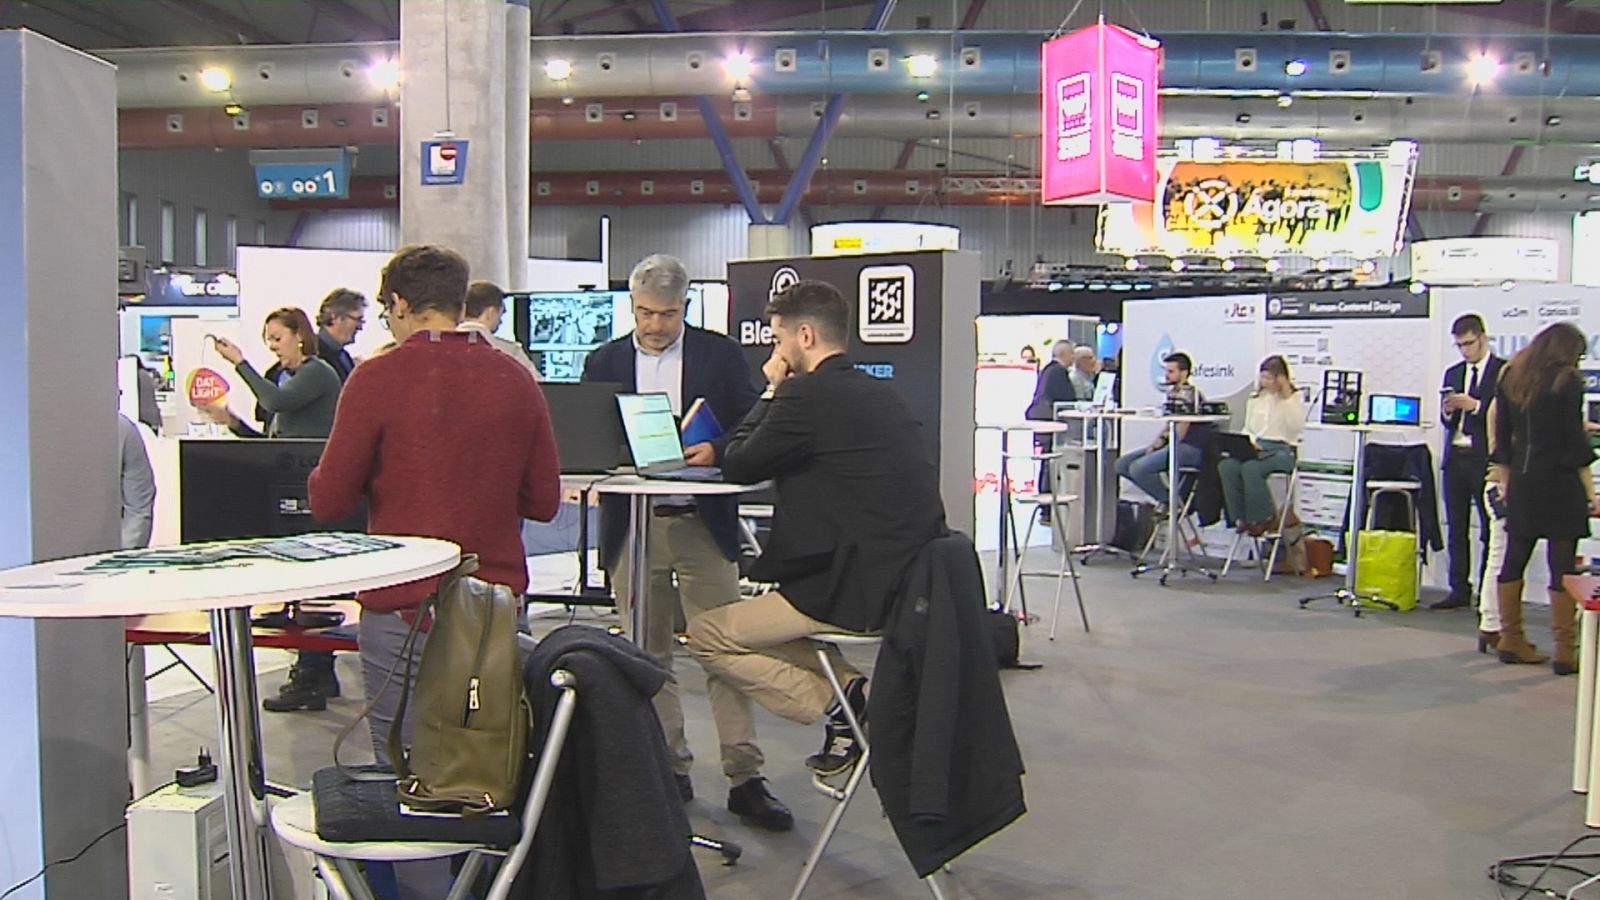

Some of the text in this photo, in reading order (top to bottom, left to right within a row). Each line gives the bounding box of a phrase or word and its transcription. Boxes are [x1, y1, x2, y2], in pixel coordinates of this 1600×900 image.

[1241, 188, 1329, 224] Agora
[1373, 299, 1401, 314] Design
[1190, 363, 1235, 378] afesink
